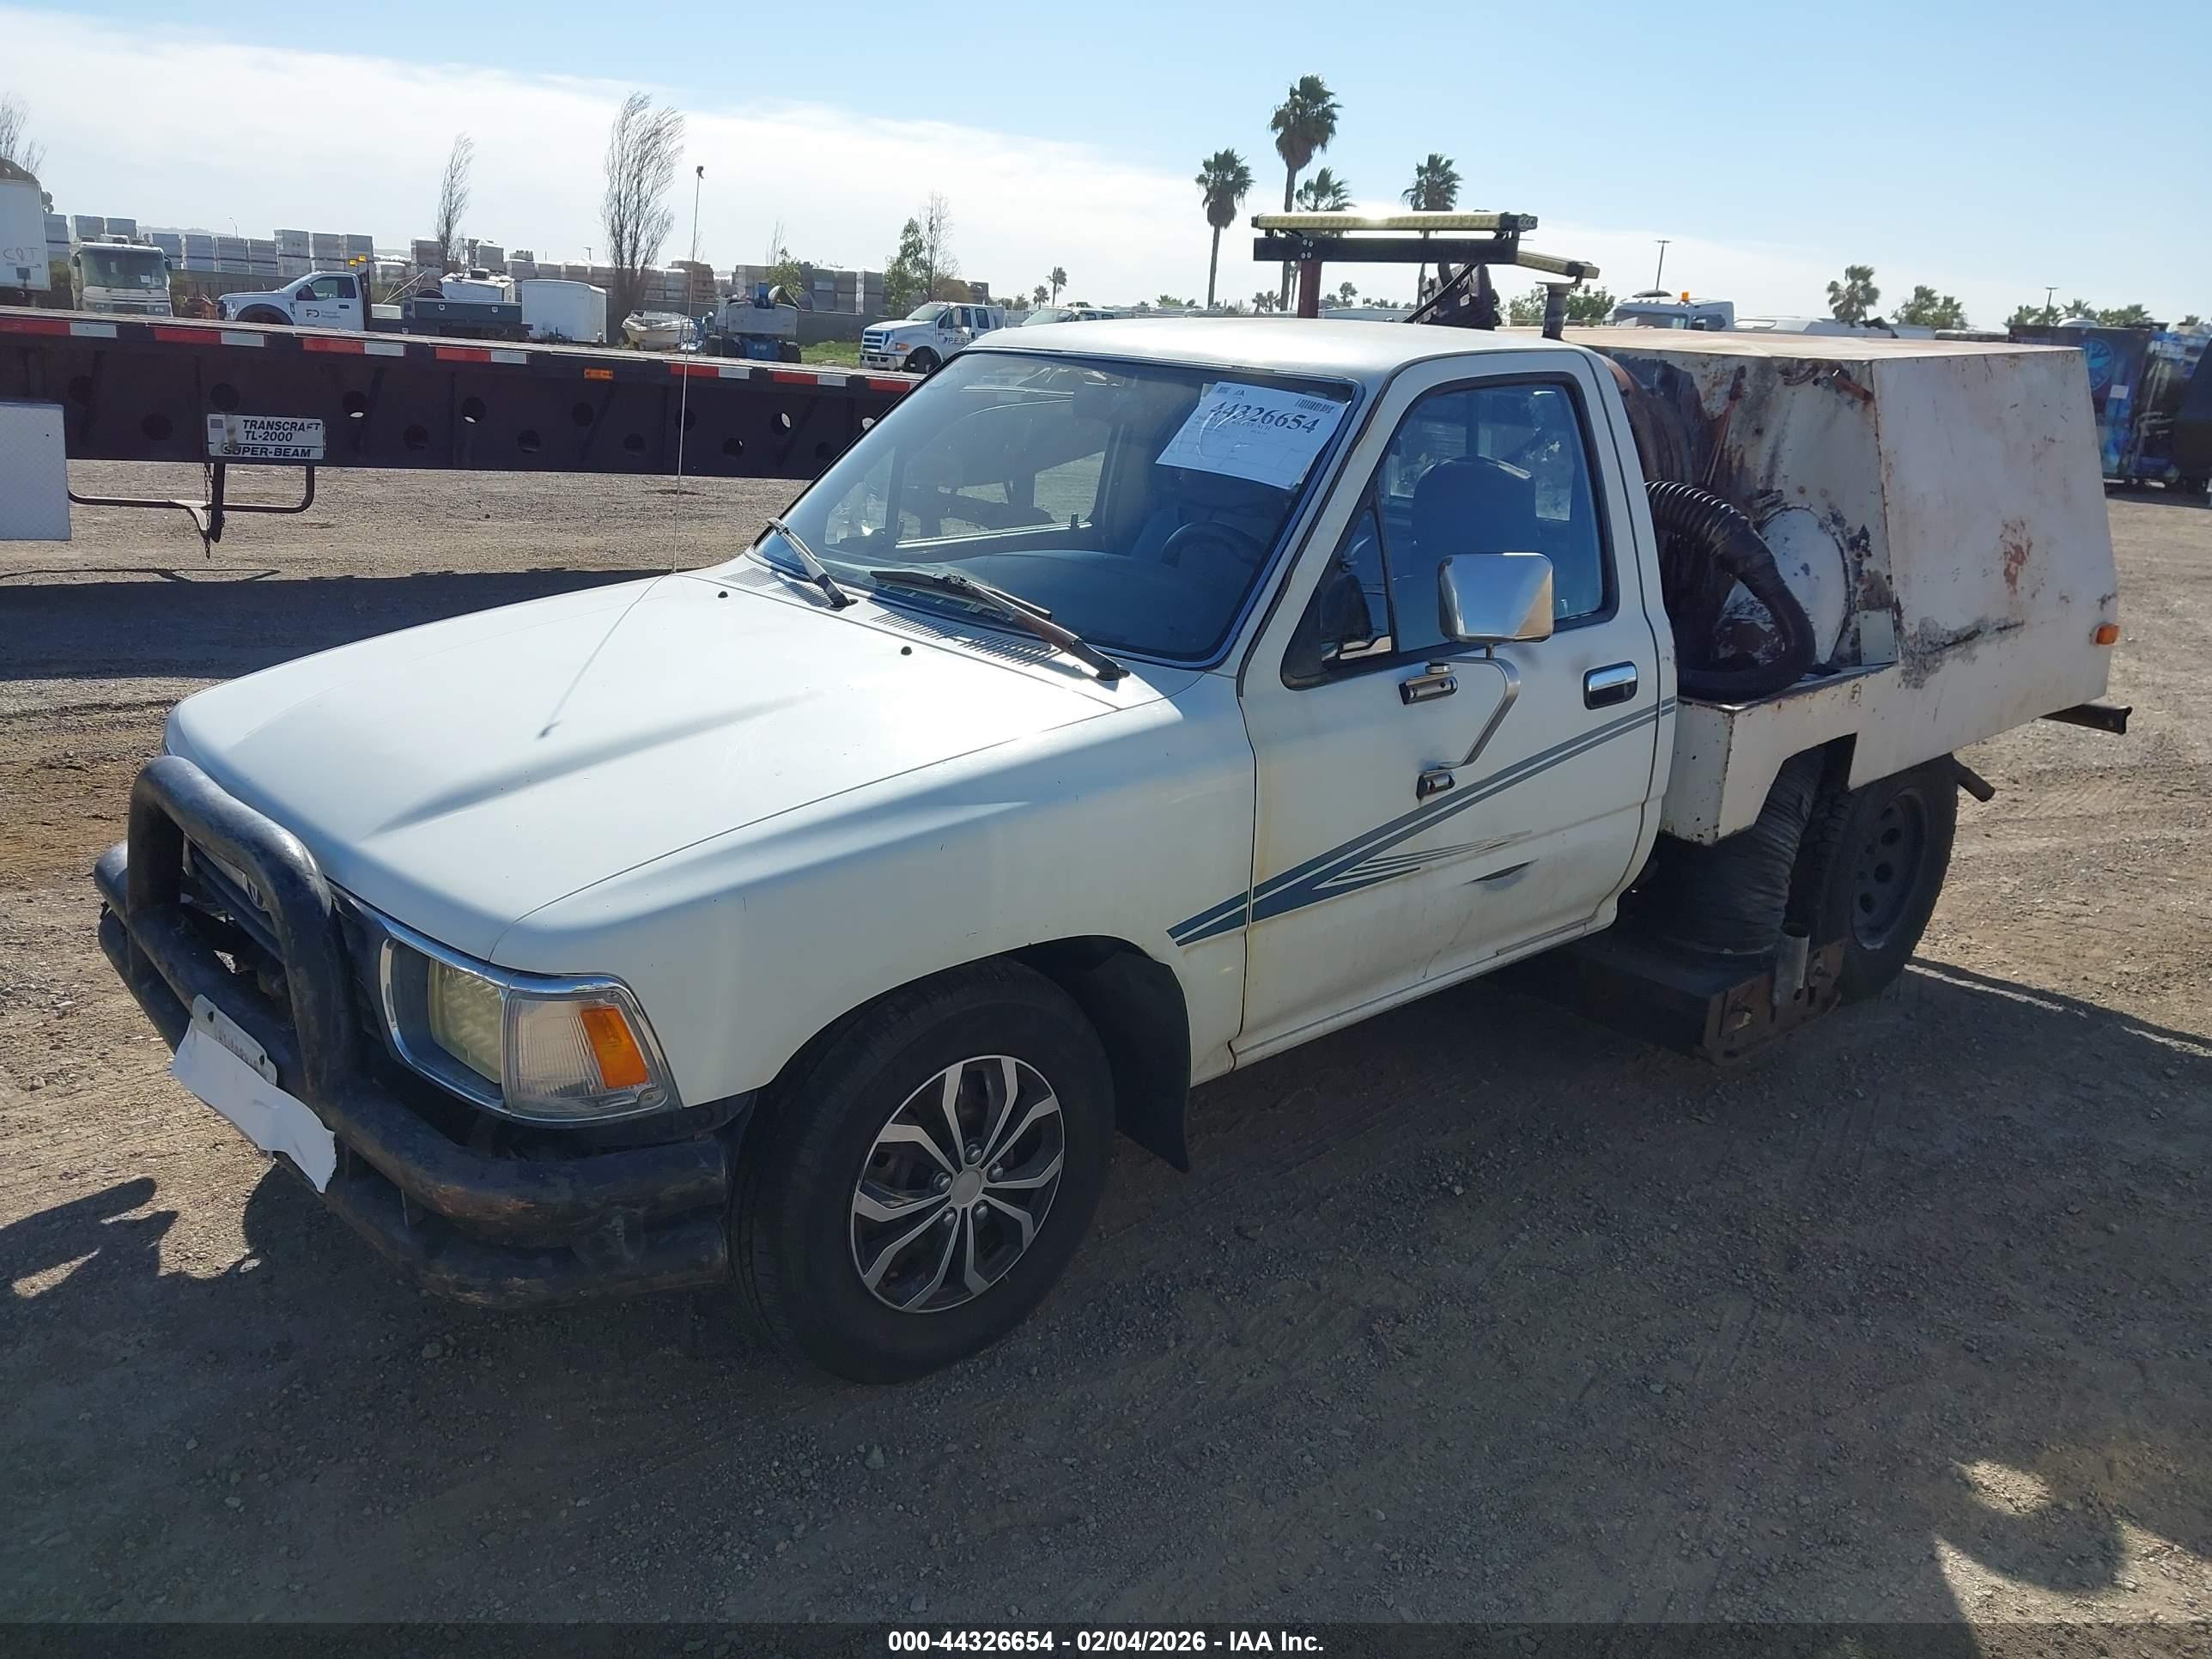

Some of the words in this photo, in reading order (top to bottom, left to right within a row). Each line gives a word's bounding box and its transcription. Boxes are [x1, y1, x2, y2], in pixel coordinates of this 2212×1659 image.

[1210, 401, 1320, 434] 44326654
[242, 419, 320, 432] TRANSCRAFT
[244, 430, 293, 442] TL-2000
[223, 446, 311, 458] SUPER-BEAM
